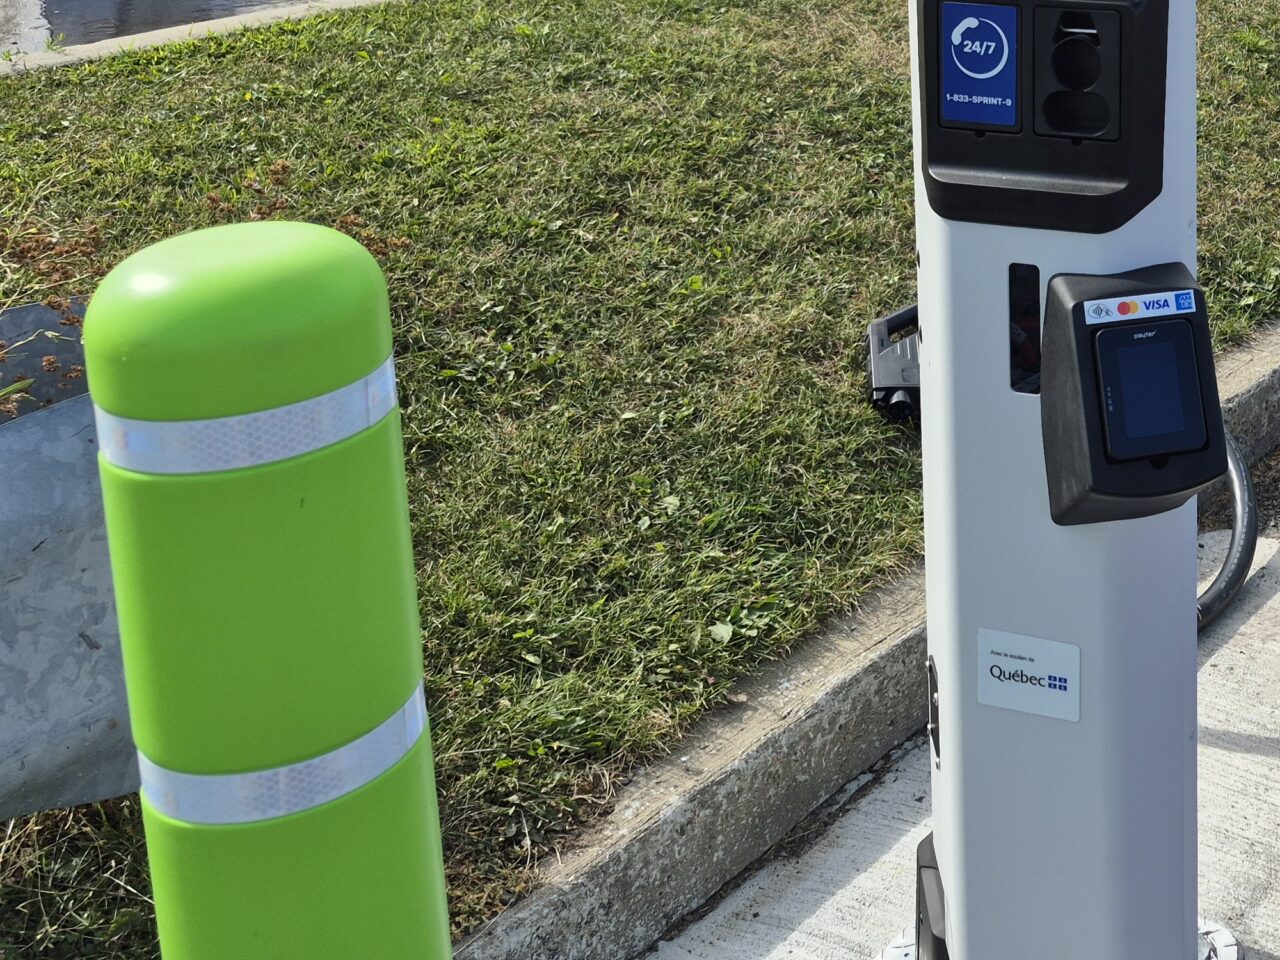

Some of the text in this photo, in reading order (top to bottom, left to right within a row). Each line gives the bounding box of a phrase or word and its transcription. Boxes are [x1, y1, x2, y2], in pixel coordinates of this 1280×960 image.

[963, 40, 996, 56] 24/7
[945, 93, 1012, 106] 1-833-SPRINT-9
[1143, 298, 1170, 311] VISA
[989, 664, 1046, 688] Québec
